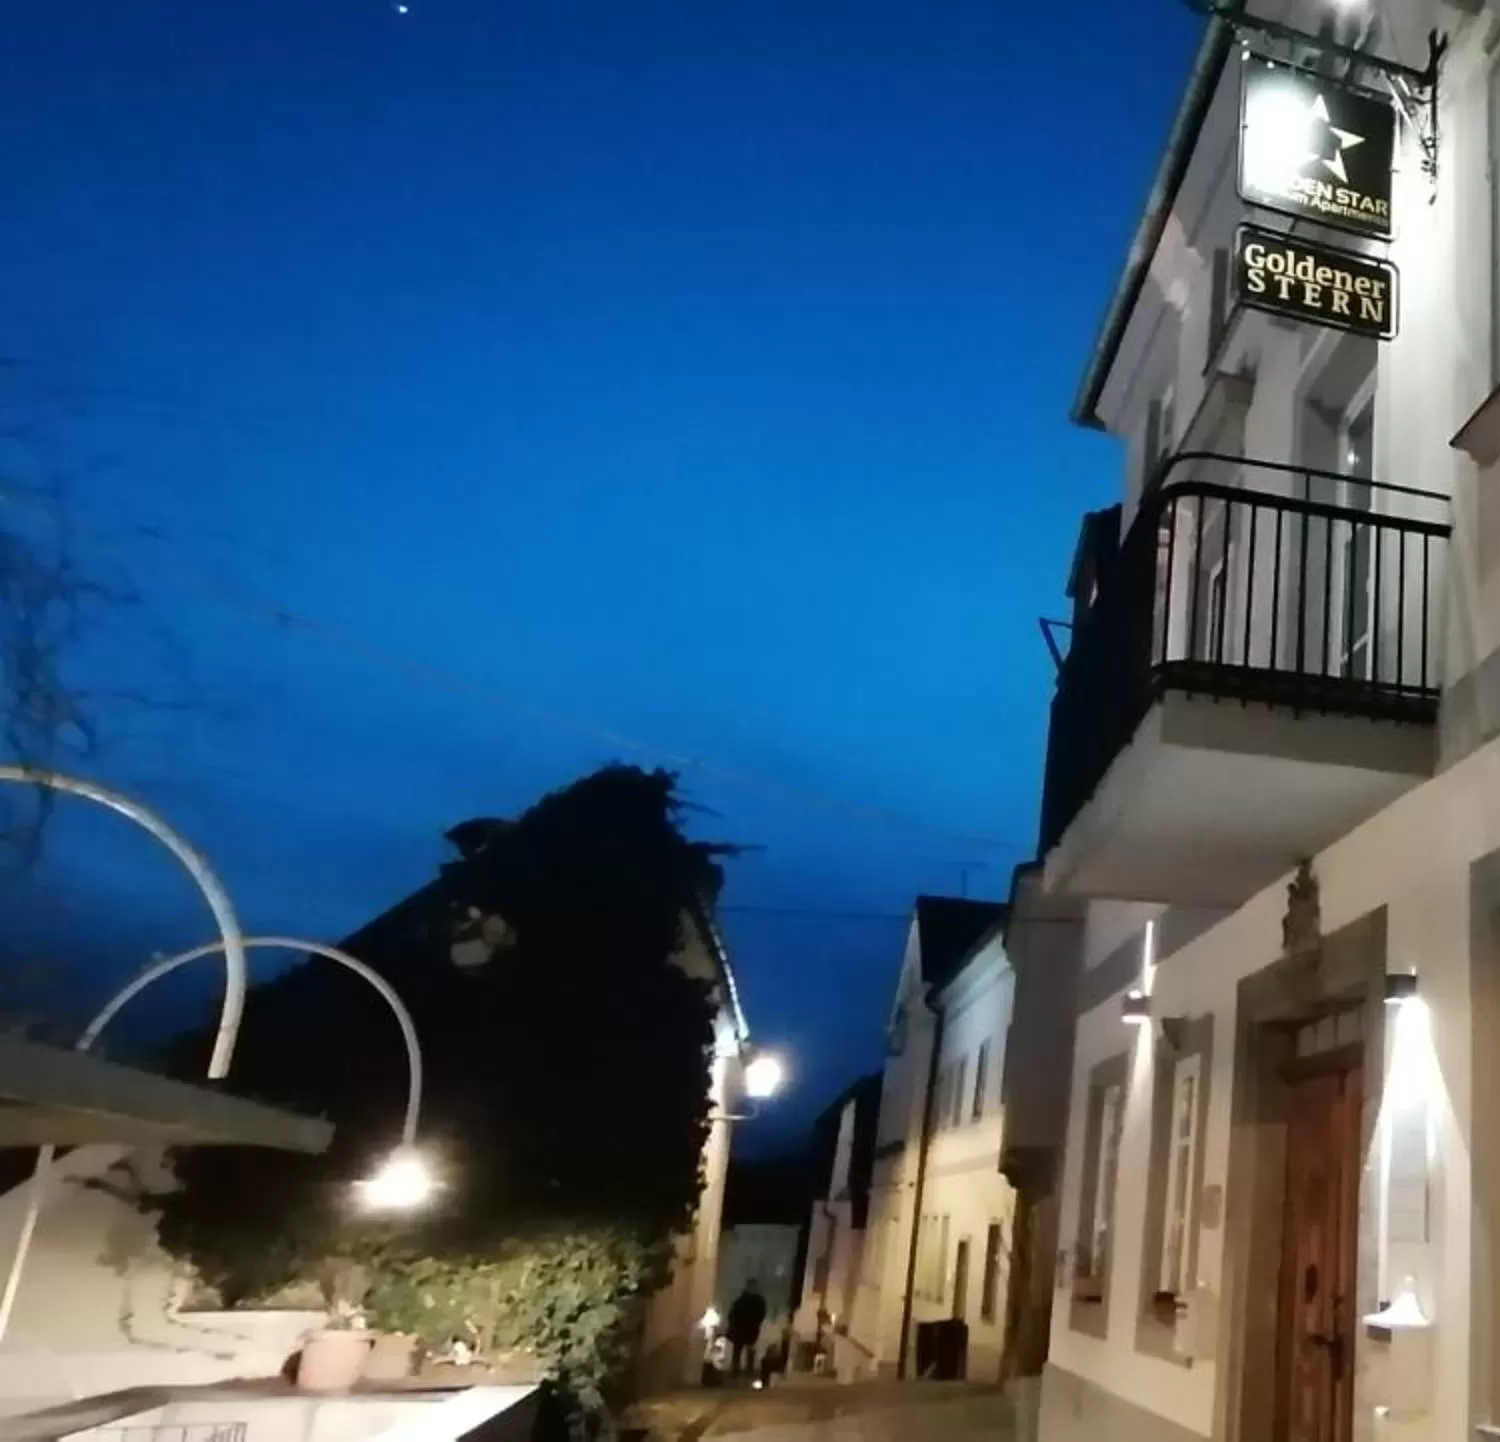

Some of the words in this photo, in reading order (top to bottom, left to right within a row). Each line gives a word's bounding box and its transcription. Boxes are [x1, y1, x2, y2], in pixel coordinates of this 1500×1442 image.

[1335, 187, 1389, 217] STAR
[1244, 243, 1385, 299] Goldener
[1247, 268, 1384, 322] STERN
